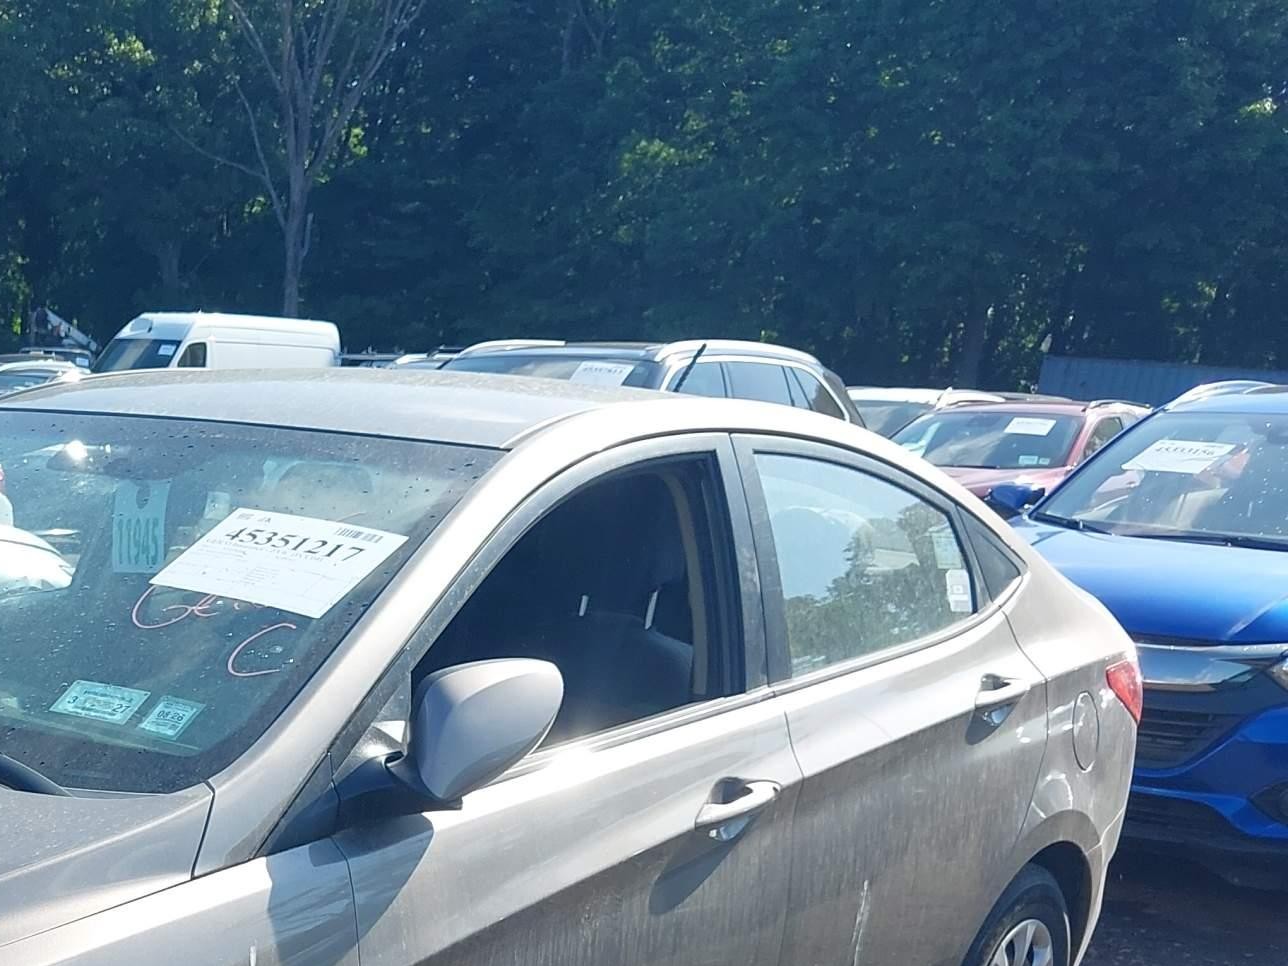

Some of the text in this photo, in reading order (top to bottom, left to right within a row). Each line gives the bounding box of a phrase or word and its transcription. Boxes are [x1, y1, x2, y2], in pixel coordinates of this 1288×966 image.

[115, 517, 160, 566] 11945
[225, 527, 366, 562] 45351217
[67, 695, 78, 705] 3
[112, 703, 131, 714] 27
